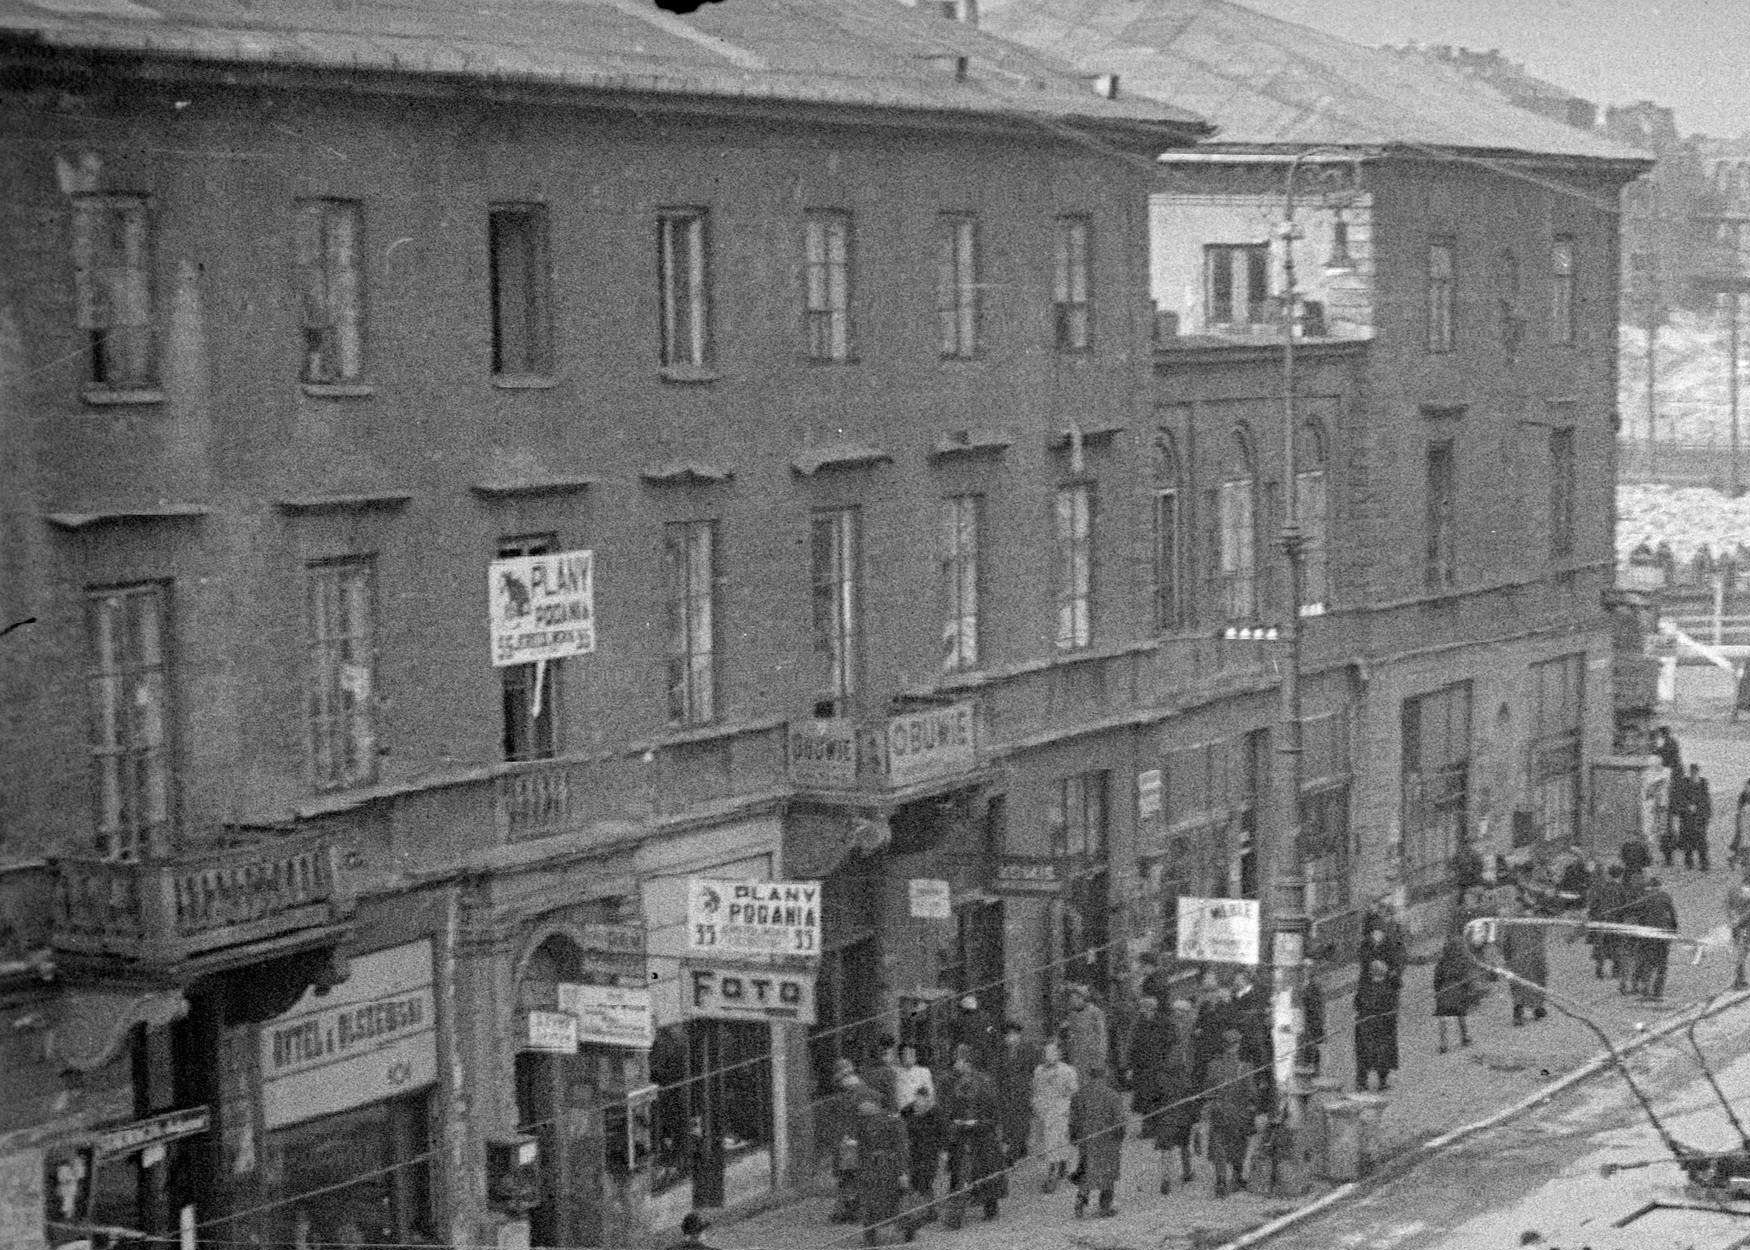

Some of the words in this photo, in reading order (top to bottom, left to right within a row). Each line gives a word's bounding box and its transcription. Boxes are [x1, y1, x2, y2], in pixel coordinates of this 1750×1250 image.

[531, 558, 590, 597] PLANY
[734, 885, 816, 901] PLANY
[728, 903, 816, 928] PODANIA
[693, 970, 803, 1007] FOTO
